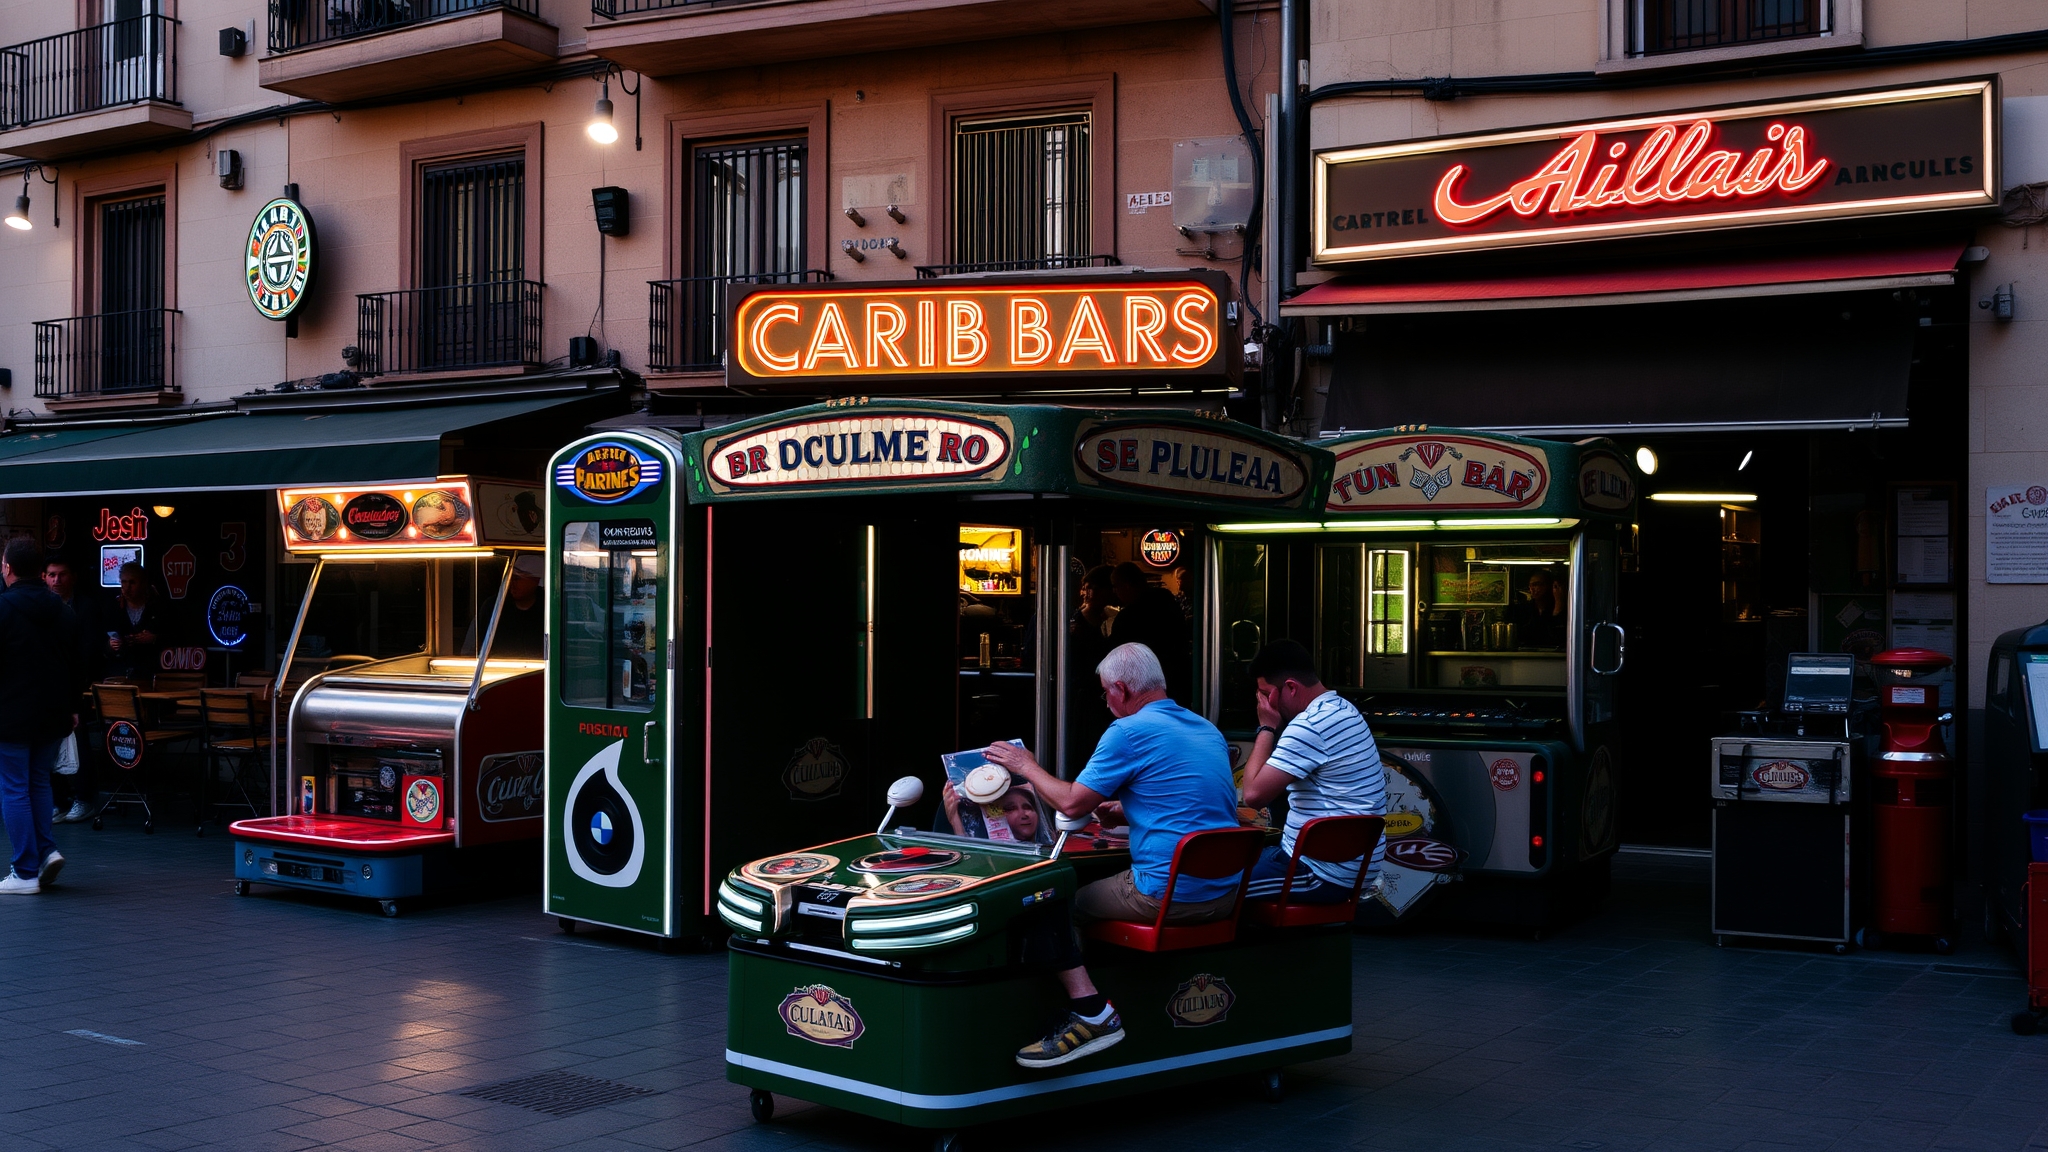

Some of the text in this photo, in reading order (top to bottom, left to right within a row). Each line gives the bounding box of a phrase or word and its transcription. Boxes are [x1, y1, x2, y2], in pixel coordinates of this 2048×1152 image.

[1834, 155, 1973, 186] ARNCULES
[1332, 208, 1428, 232] CARTREL
[750, 294, 1212, 371] CARIB BARS
[726, 430, 990, 479] BR DCULME RO
[1097, 439, 1284, 495] SE PLULEAA
